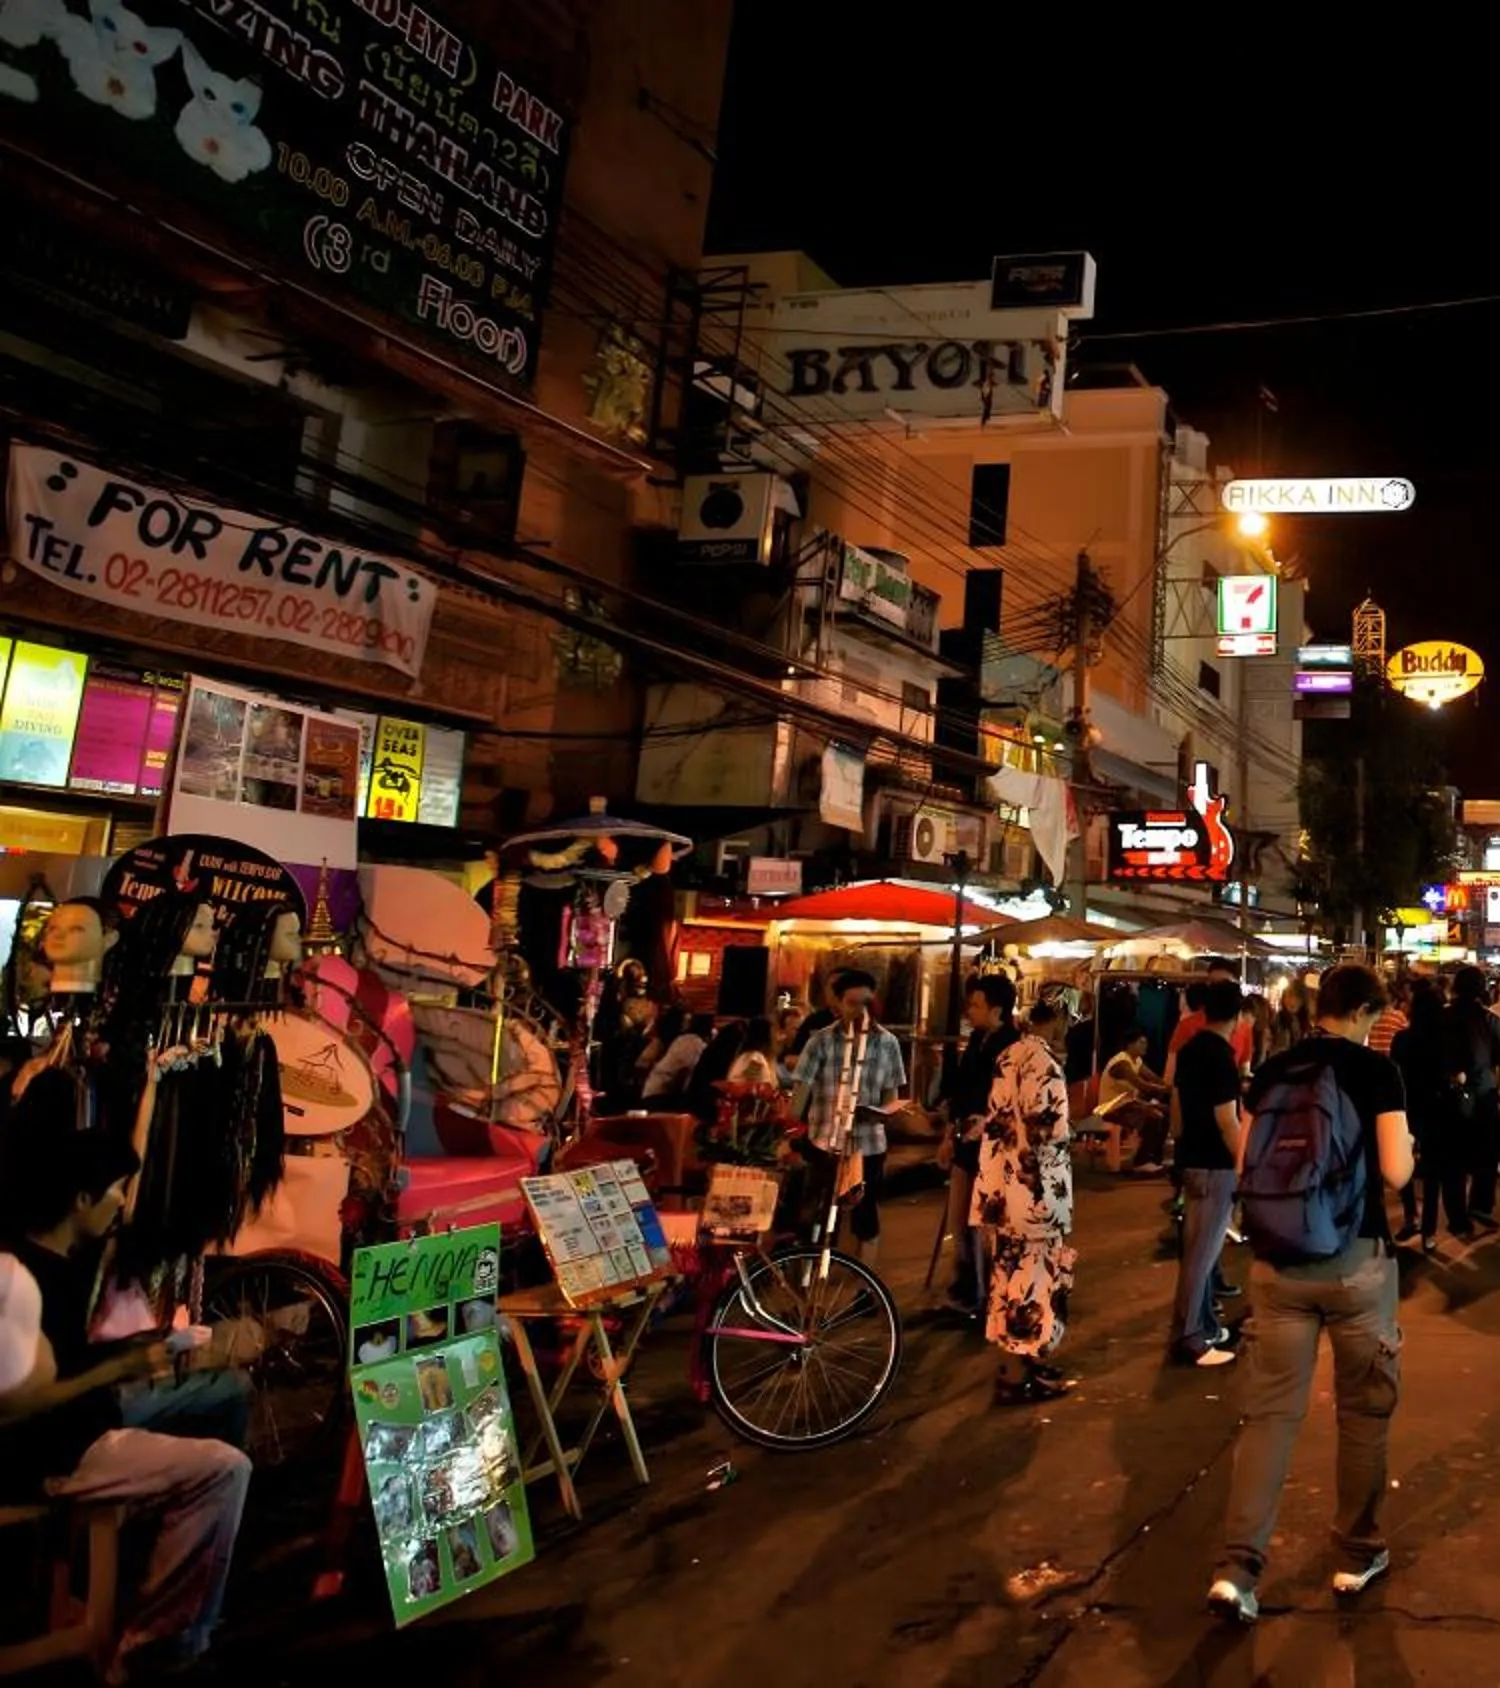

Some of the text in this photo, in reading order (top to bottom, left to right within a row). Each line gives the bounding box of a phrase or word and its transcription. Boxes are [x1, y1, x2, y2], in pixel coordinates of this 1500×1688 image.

[492, 70, 564, 155] PARK
[277, 141, 350, 208] 10.00
[357, 78, 549, 240] THAILAND
[346, 140, 543, 281] OPEN DAILY
[416, 272, 529, 375] Floor)
[1229, 484, 1376, 506] RIKKA INN
[25, 513, 96, 584] TEL.
[87, 482, 400, 602] FOR RENT
[1401, 648, 1467, 675] Buddy
[382, 739, 417, 757] SEAS
[1118, 824, 1198, 853] Tempo
